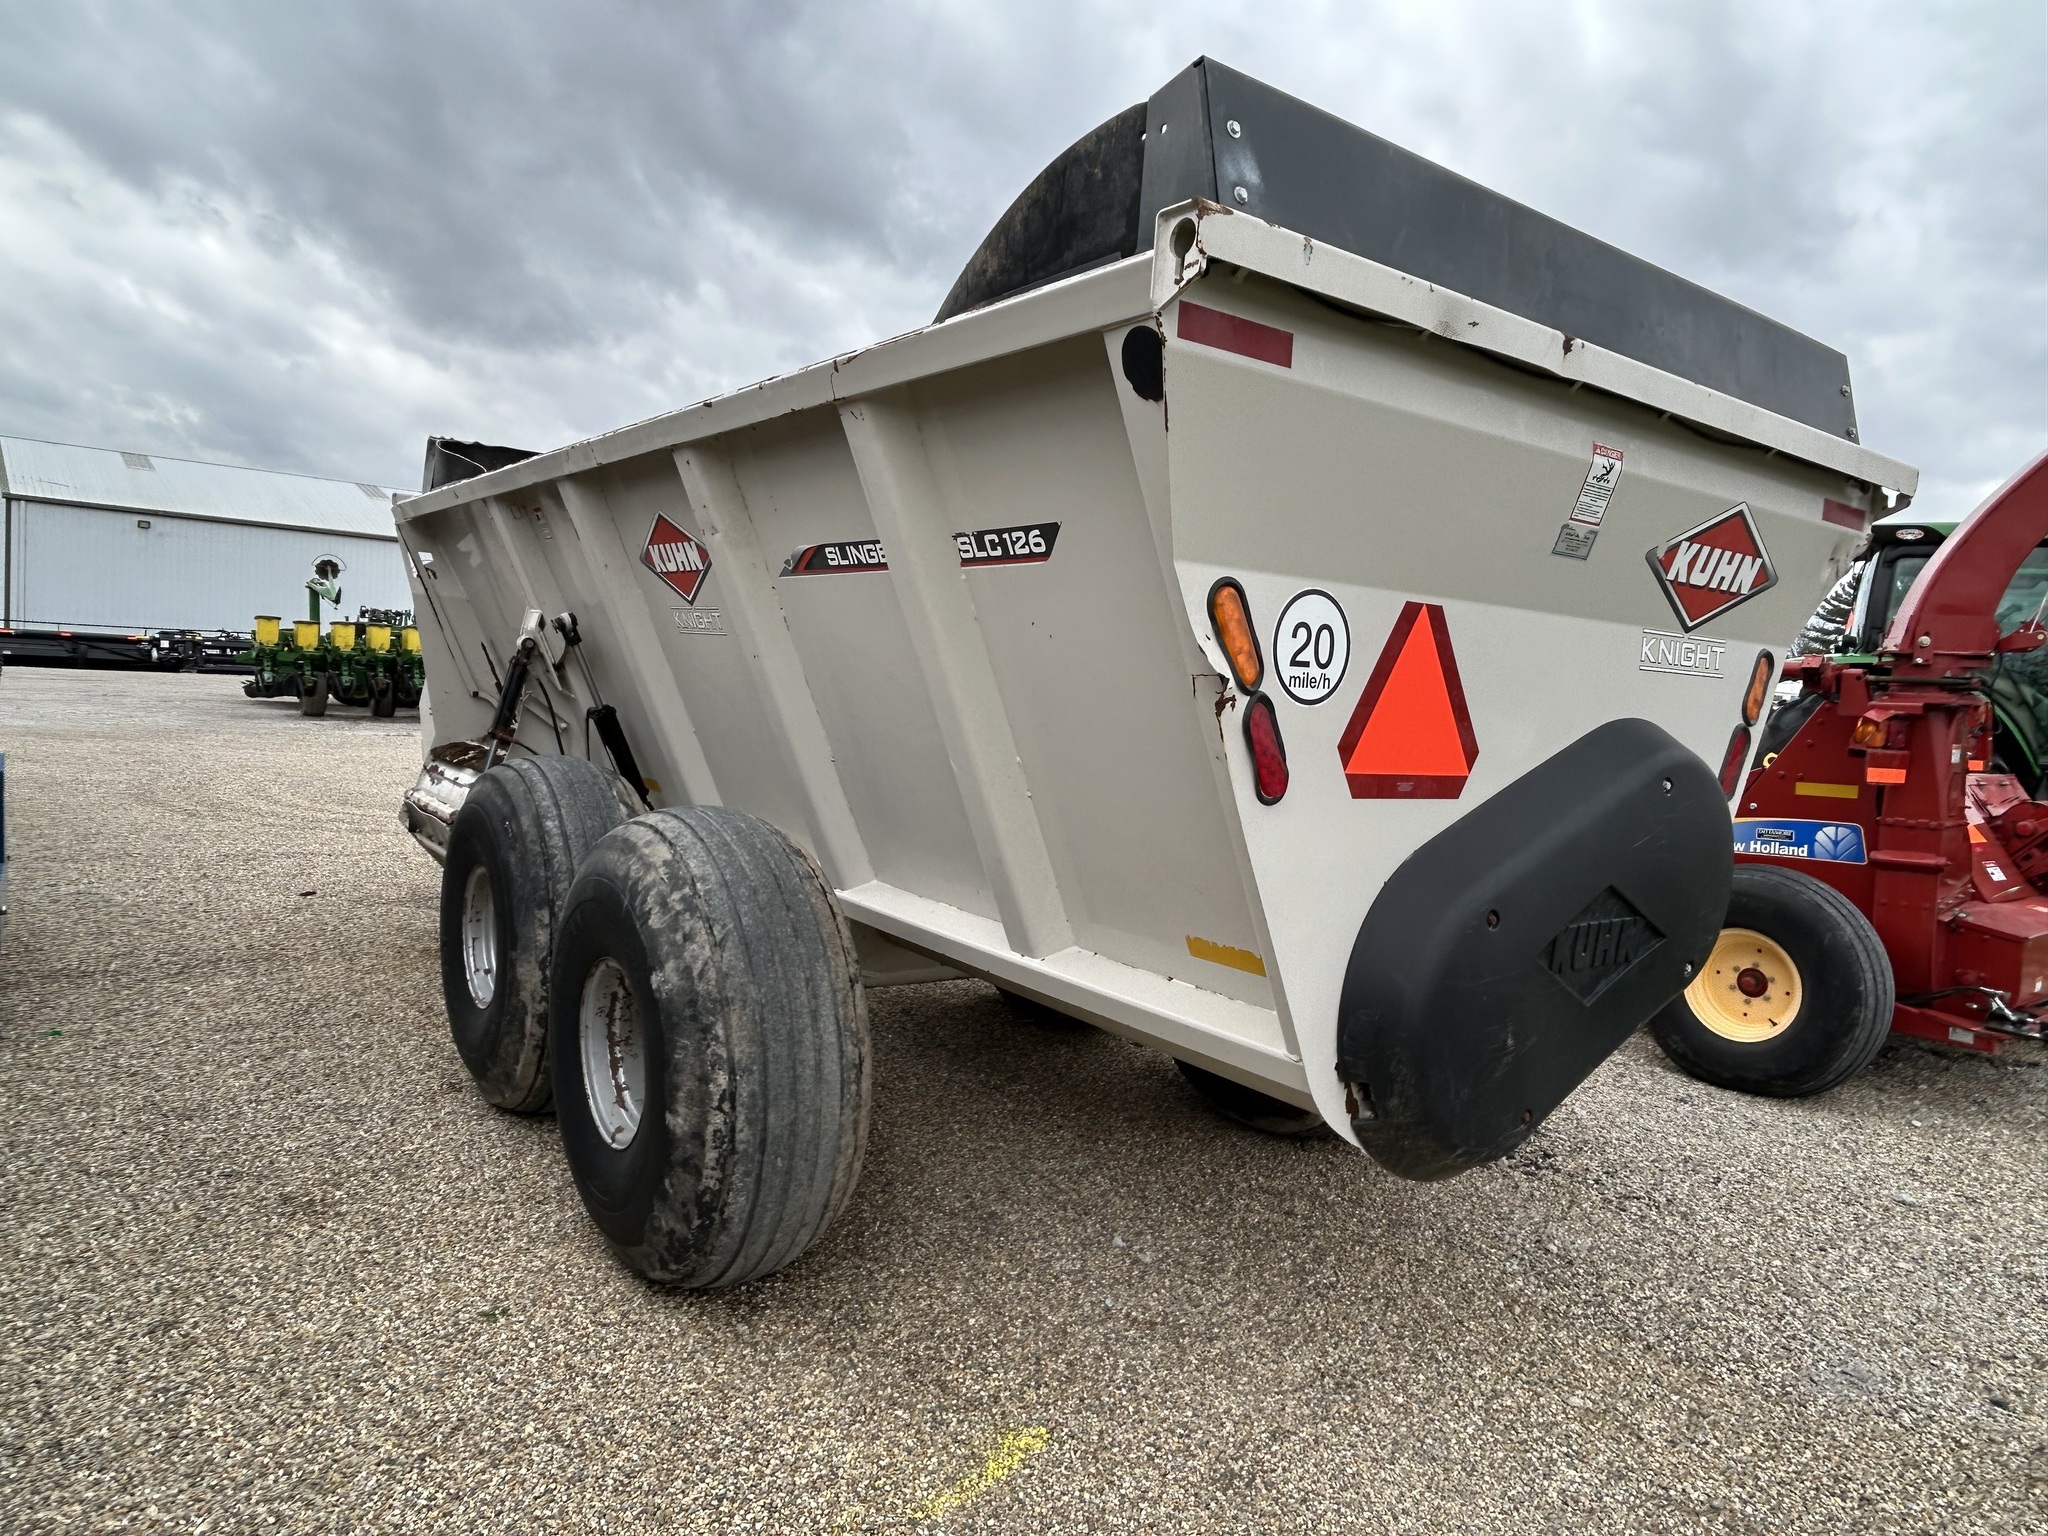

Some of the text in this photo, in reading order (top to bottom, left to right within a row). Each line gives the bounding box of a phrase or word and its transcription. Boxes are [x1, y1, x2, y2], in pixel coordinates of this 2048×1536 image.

[648, 541, 704, 573] KUHN
[956, 529, 1046, 559] SLC 126
[1665, 541, 1763, 596] KUHN
[673, 612, 724, 631] KNIGHT
[1289, 621, 1335, 670] 20
[1640, 636, 1726, 671] KNIGHT
[1288, 672, 1331, 690] mile/h
[1750, 840, 1809, 857] Holland
[1550, 917, 1646, 975] KUHN
